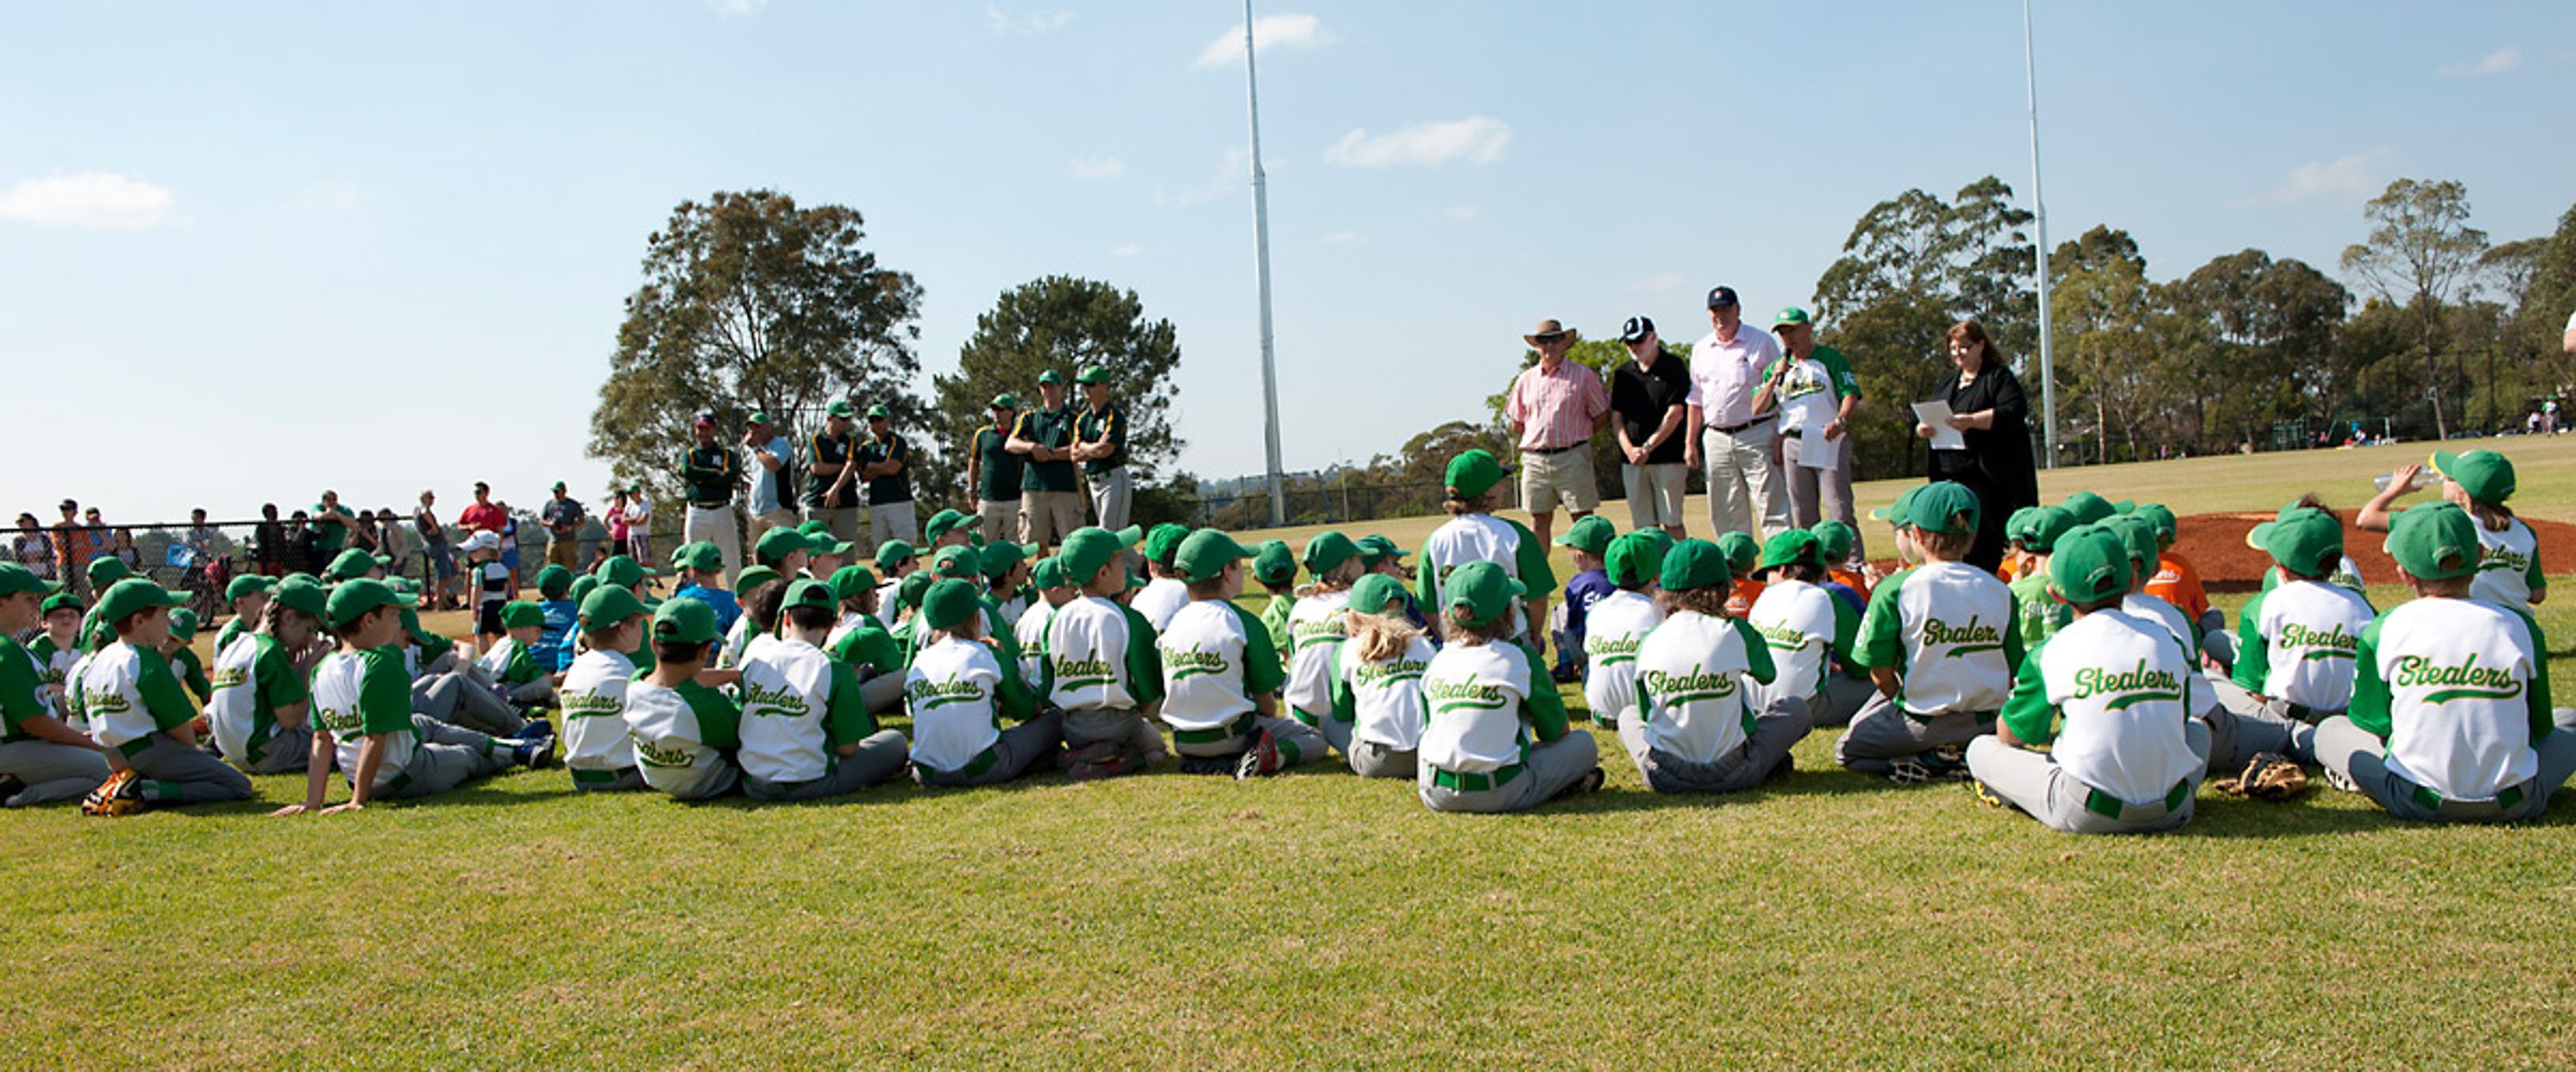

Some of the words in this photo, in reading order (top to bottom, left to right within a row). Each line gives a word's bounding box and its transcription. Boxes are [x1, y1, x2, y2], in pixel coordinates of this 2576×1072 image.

[2280, 623, 2360, 651] Stealer
[1648, 663, 1728, 697] Stealers
[2397, 653, 2512, 688] Stealers
[913, 672, 980, 701] Stealers
[1429, 673, 1501, 703] Stealers
